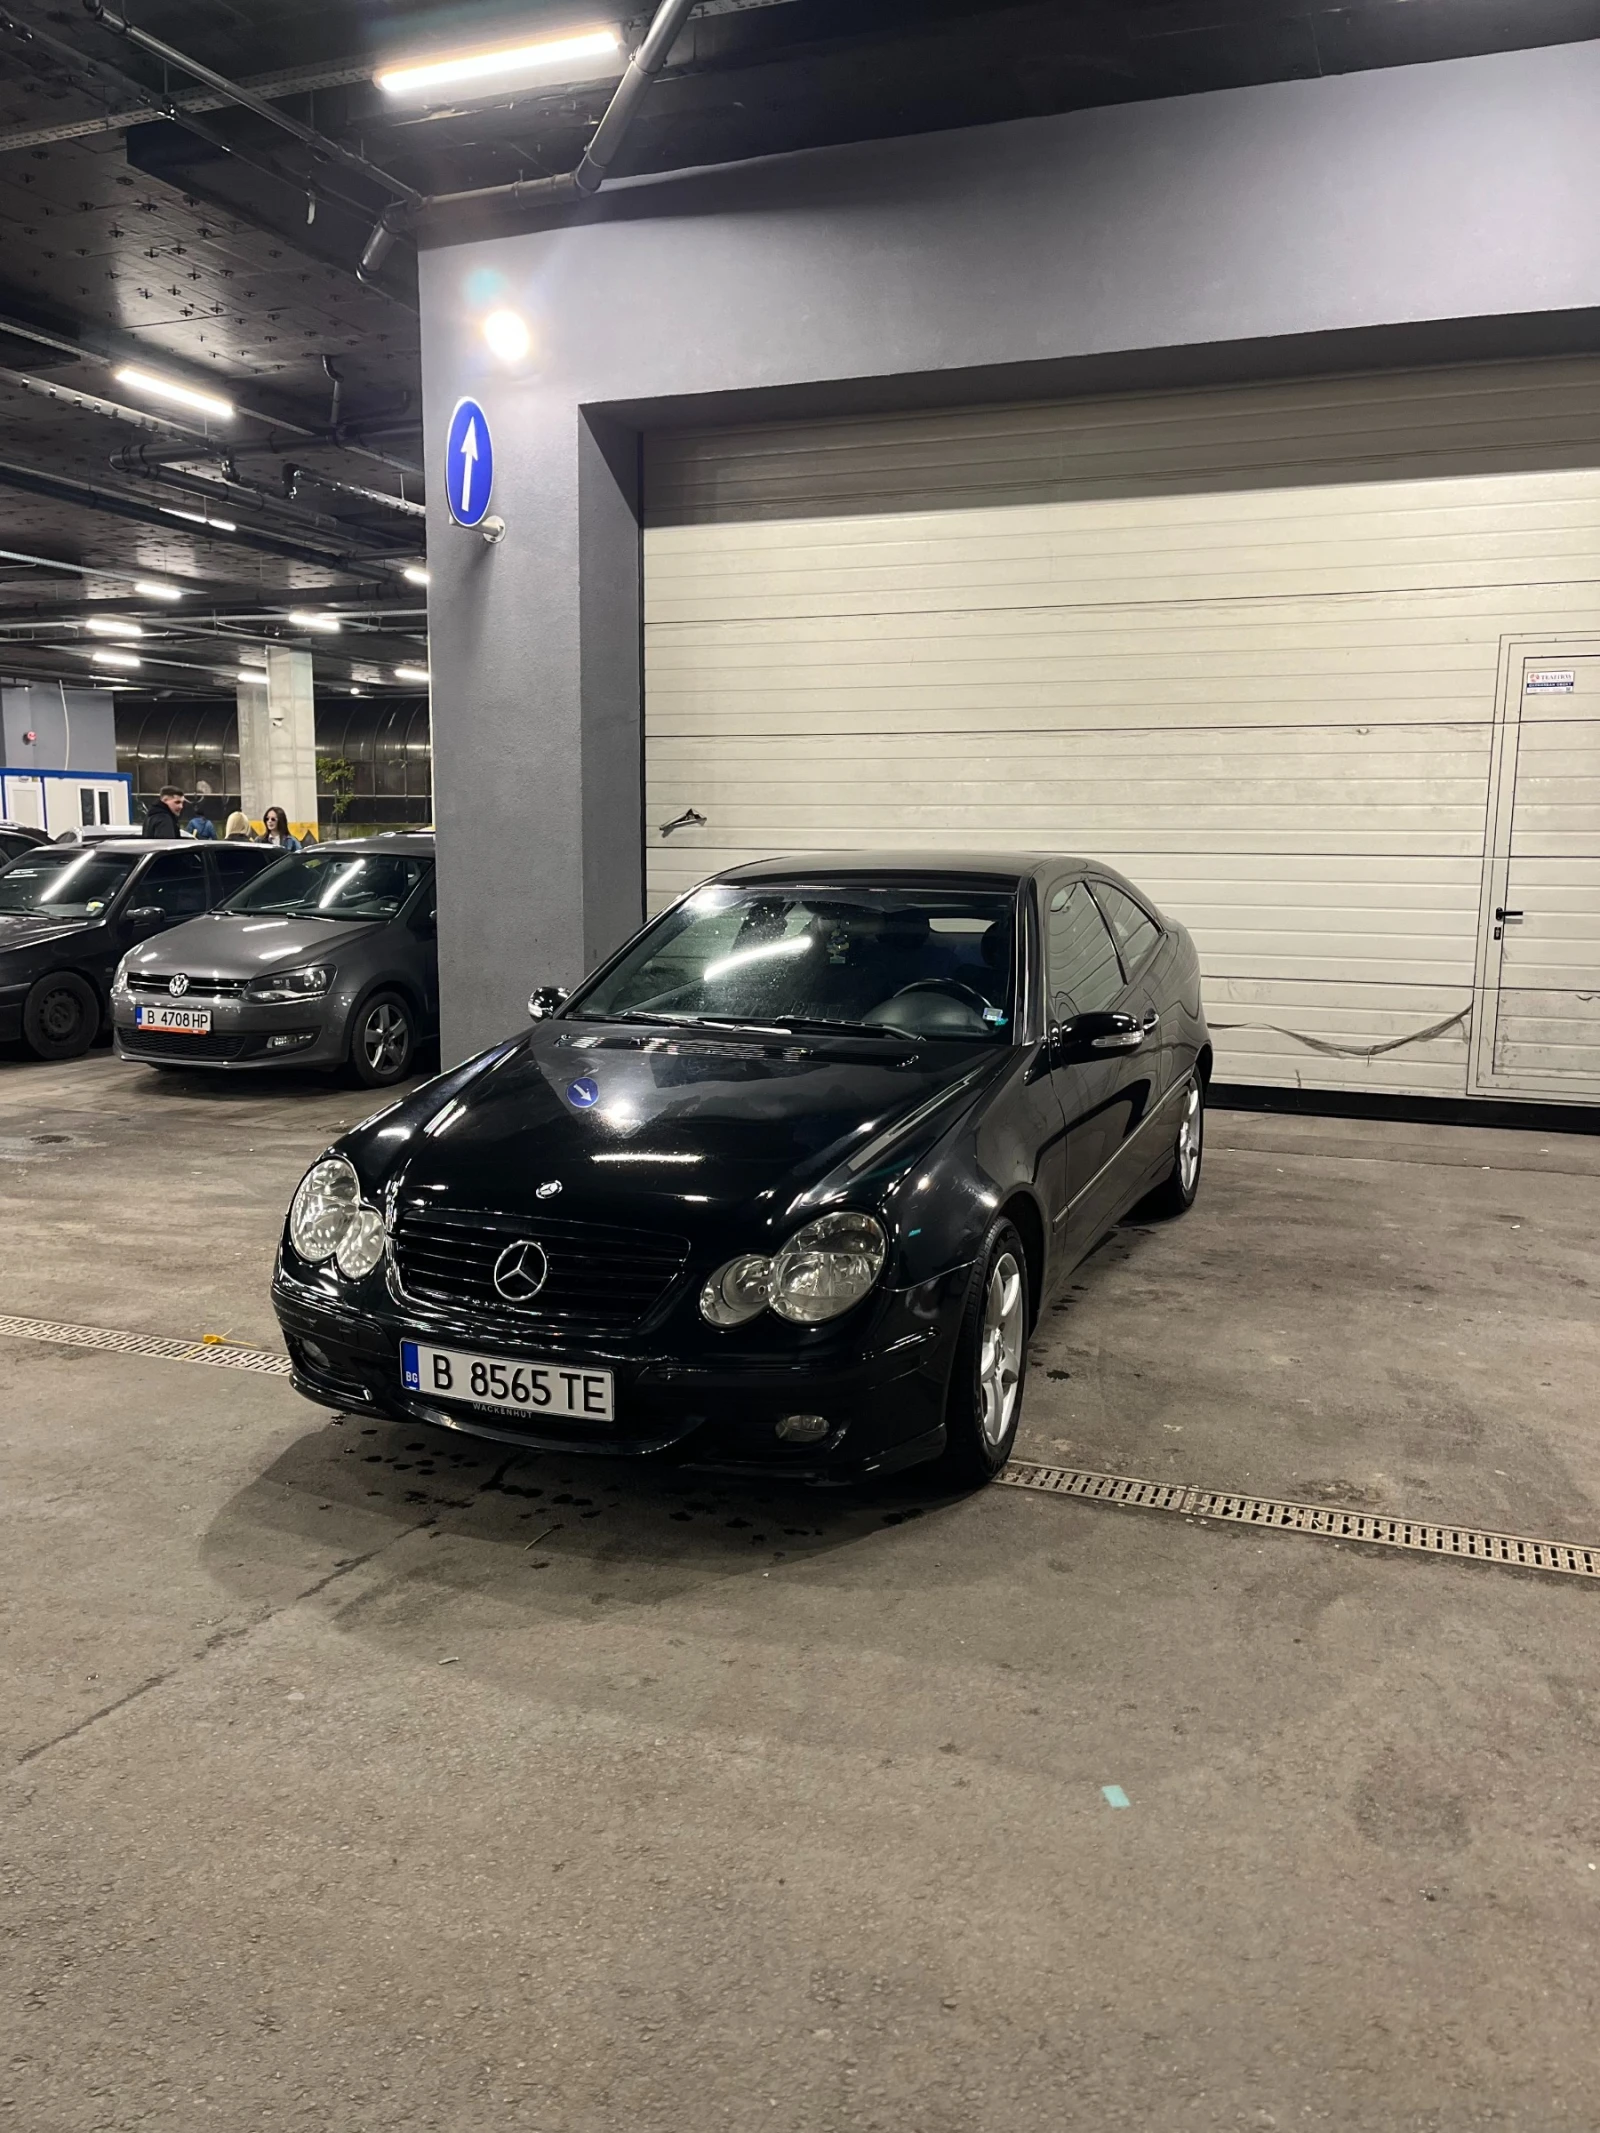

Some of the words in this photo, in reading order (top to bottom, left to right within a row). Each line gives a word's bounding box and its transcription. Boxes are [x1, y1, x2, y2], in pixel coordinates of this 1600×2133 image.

[147, 1010, 155, 1025] B
[161, 1011, 190, 1027] 4708
[192, 1013, 208, 1028] HP
[405, 1371, 418, 1383] BG
[432, 1353, 453, 1390] B
[470, 1361, 551, 1406] 8565
[559, 1372, 607, 1414] TE
[472, 1402, 533, 1419] WACKENHUT
